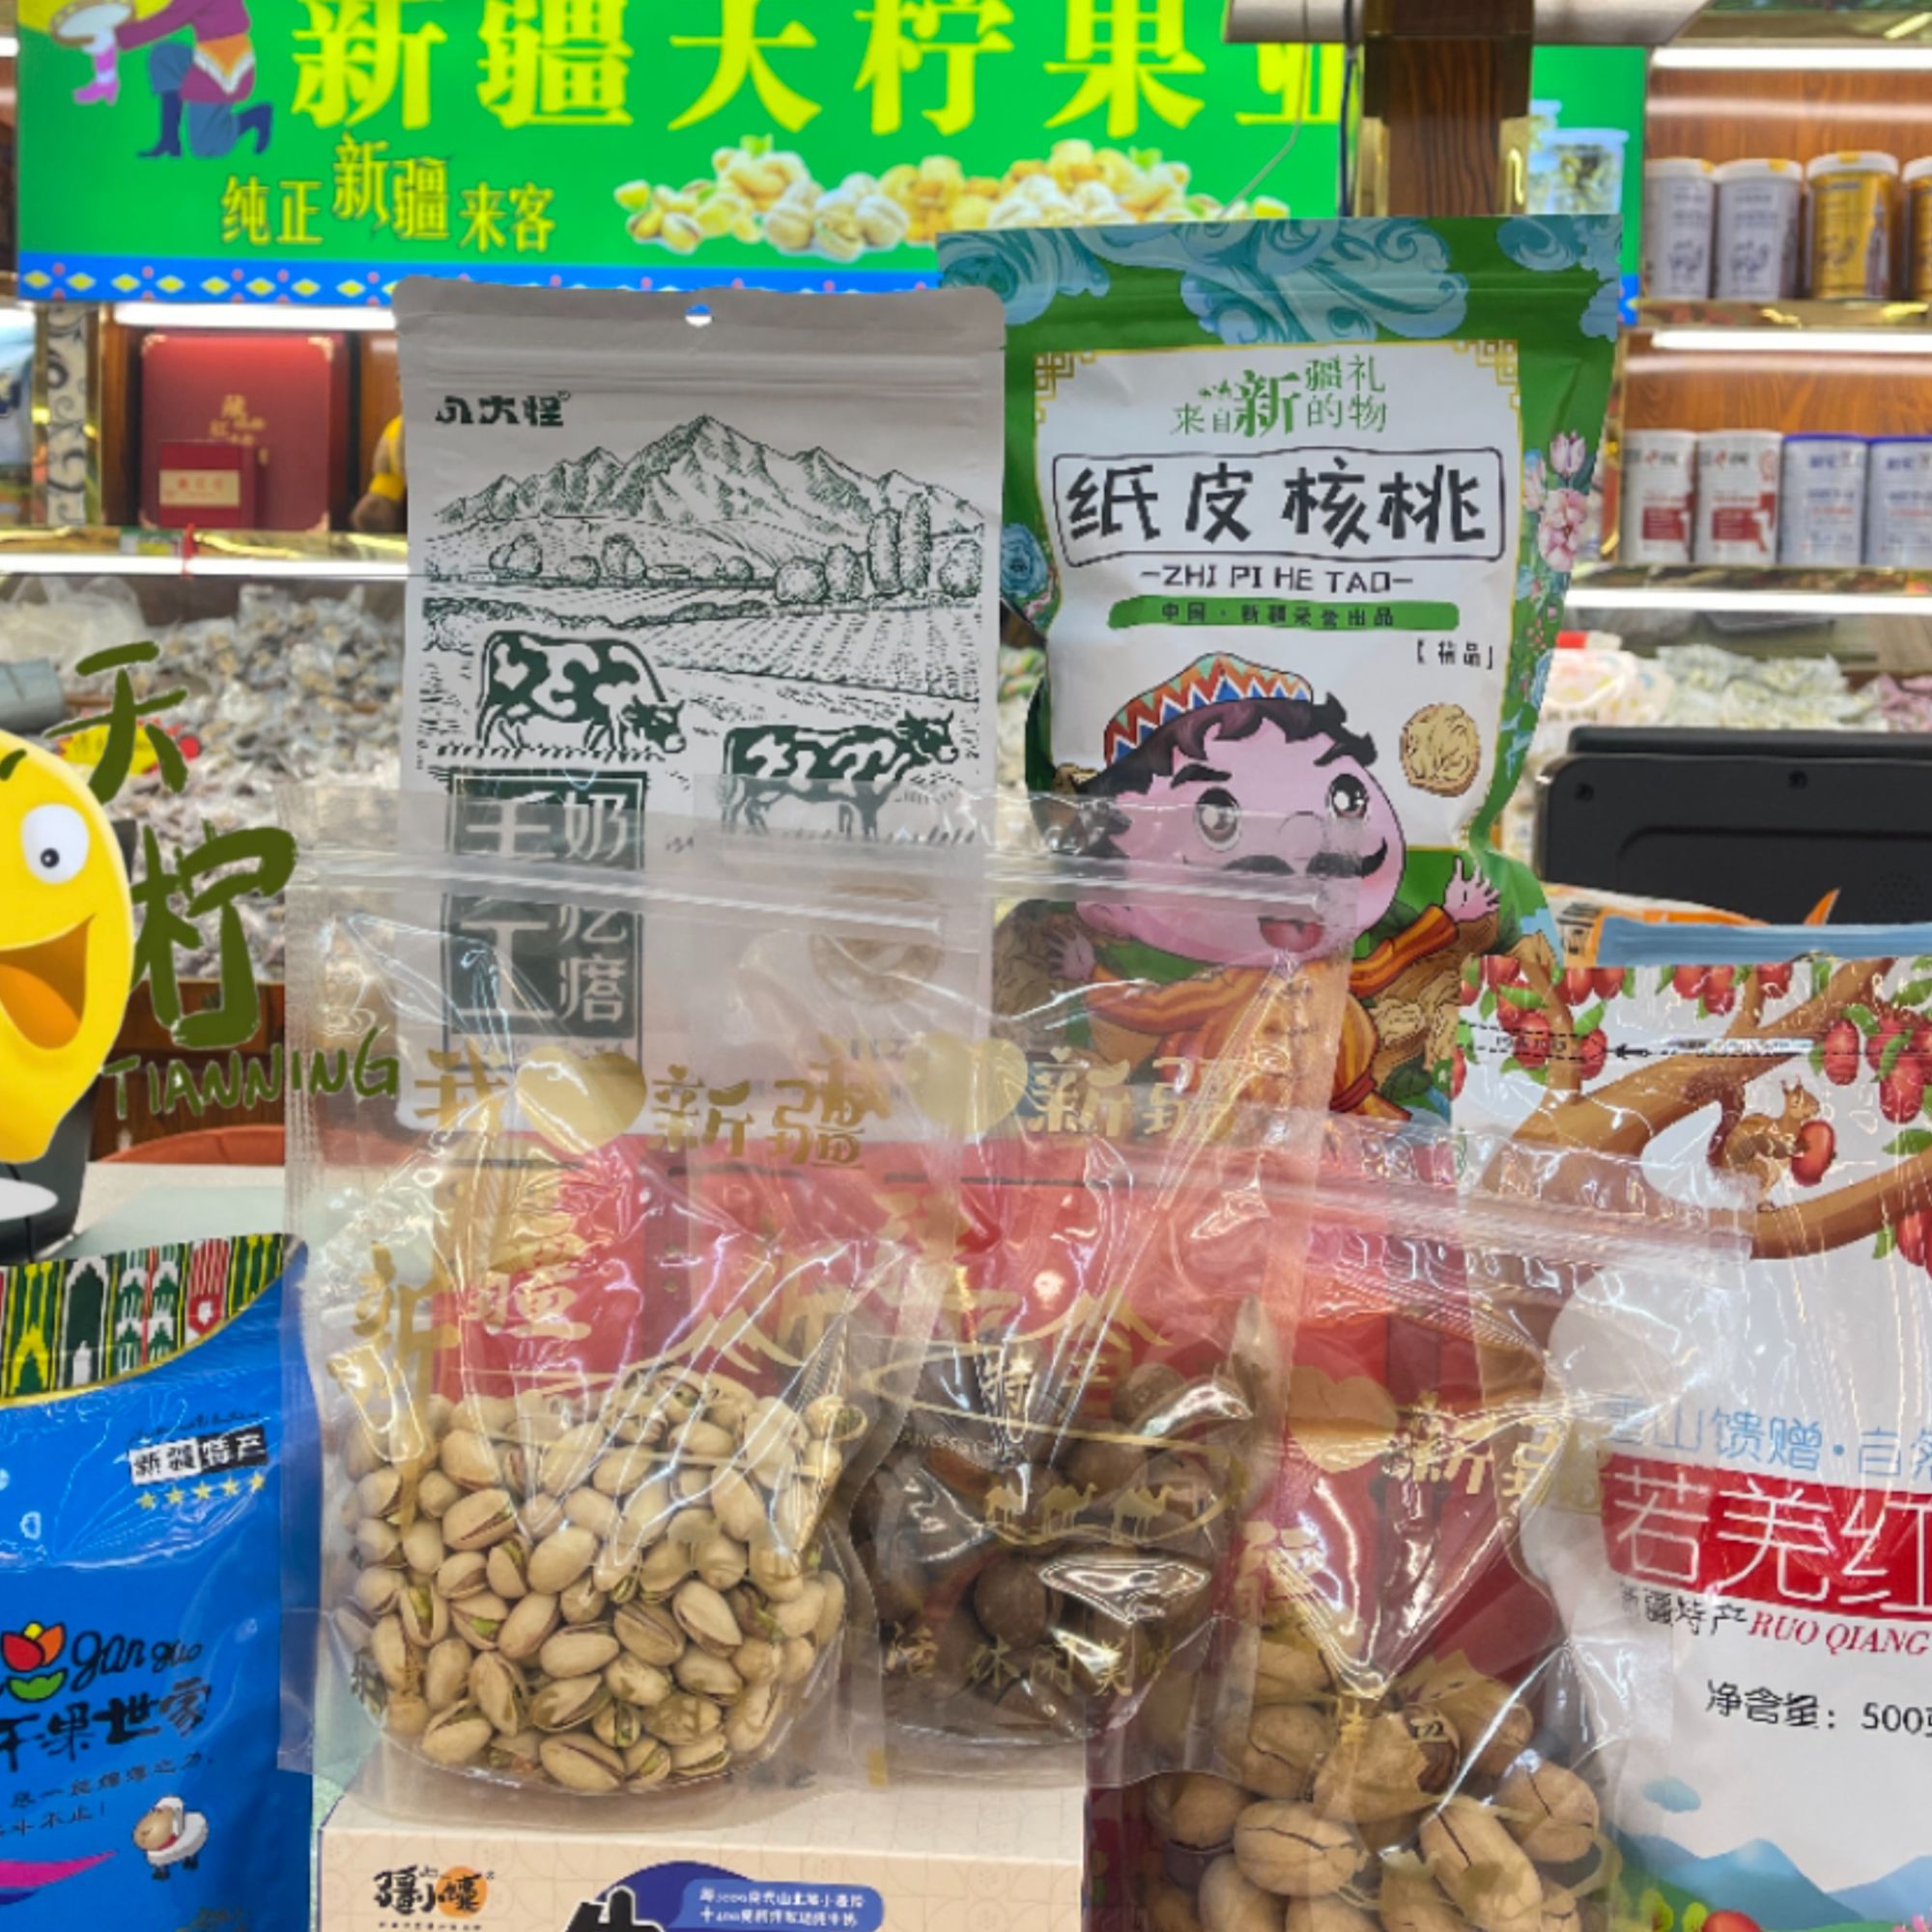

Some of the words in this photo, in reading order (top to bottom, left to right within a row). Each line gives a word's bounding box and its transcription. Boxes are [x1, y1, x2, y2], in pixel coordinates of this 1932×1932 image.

[1066, 455, 1486, 550] 纸皮核桃
[100, 1026, 397, 1121] TIANNING
[1748, 1610, 1819, 1644] RUO
[1825, 1622, 1930, 1655] QIANG
